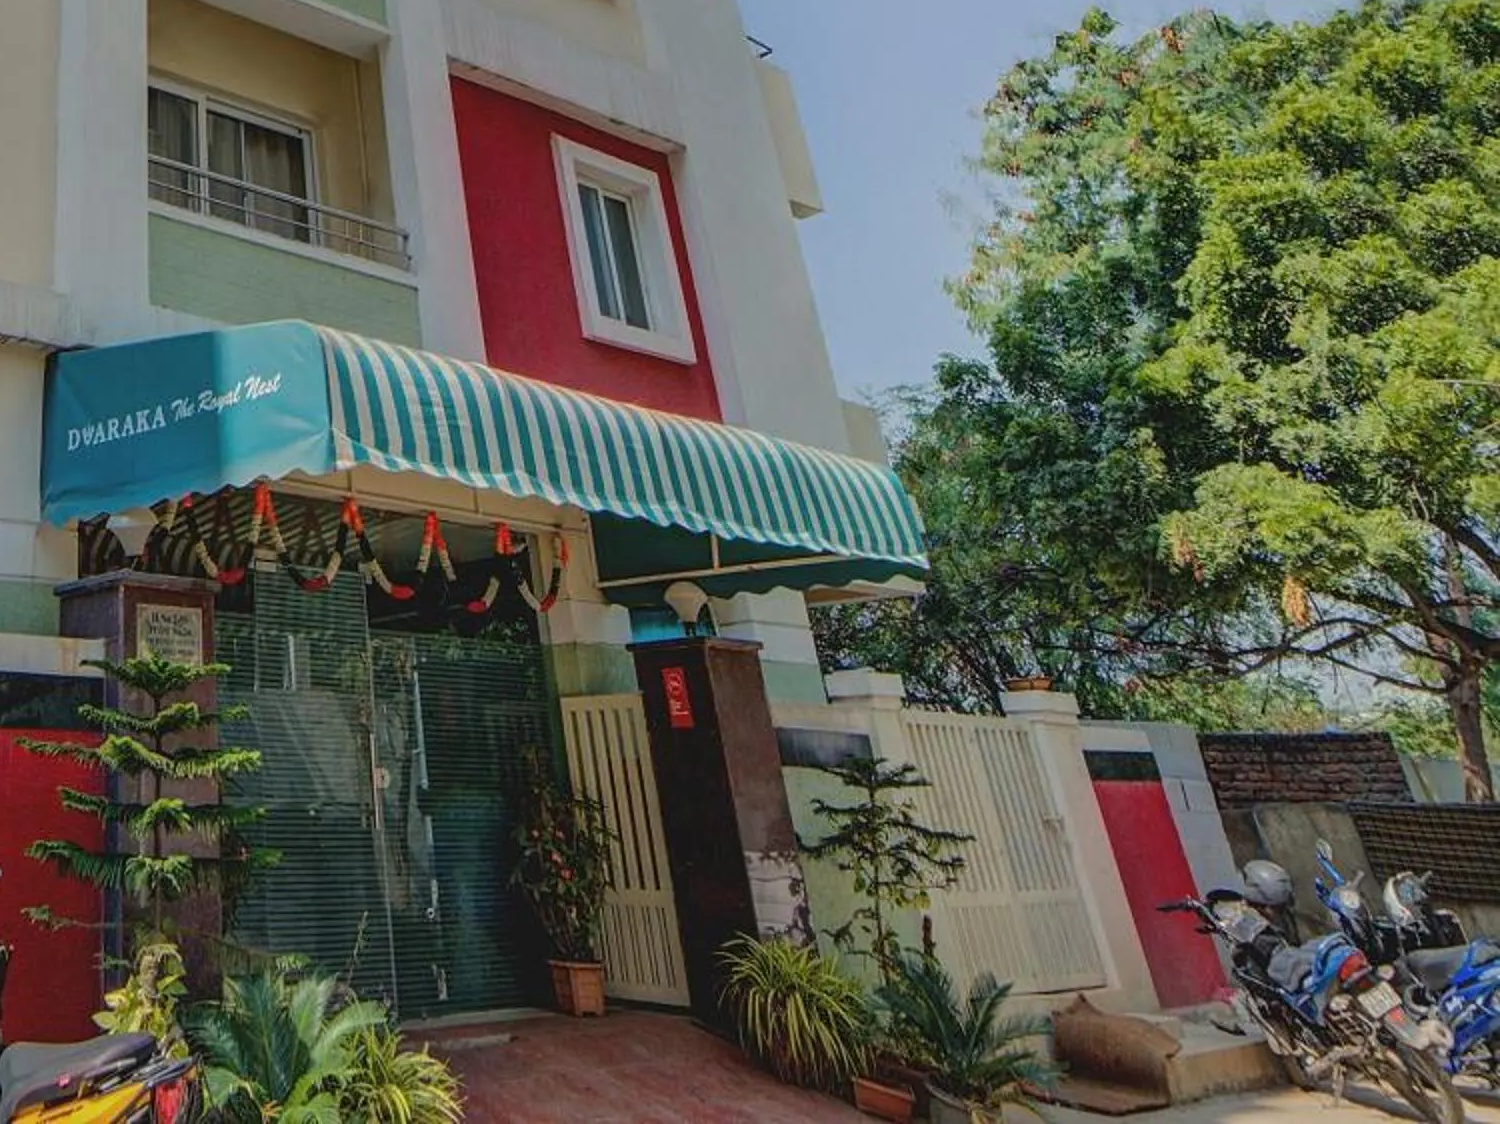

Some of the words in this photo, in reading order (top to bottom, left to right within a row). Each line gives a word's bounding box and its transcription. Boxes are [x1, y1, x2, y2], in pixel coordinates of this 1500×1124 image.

[171, 396, 196, 423] The
[197, 381, 242, 413] Royal
[243, 372, 282, 399] Nest
